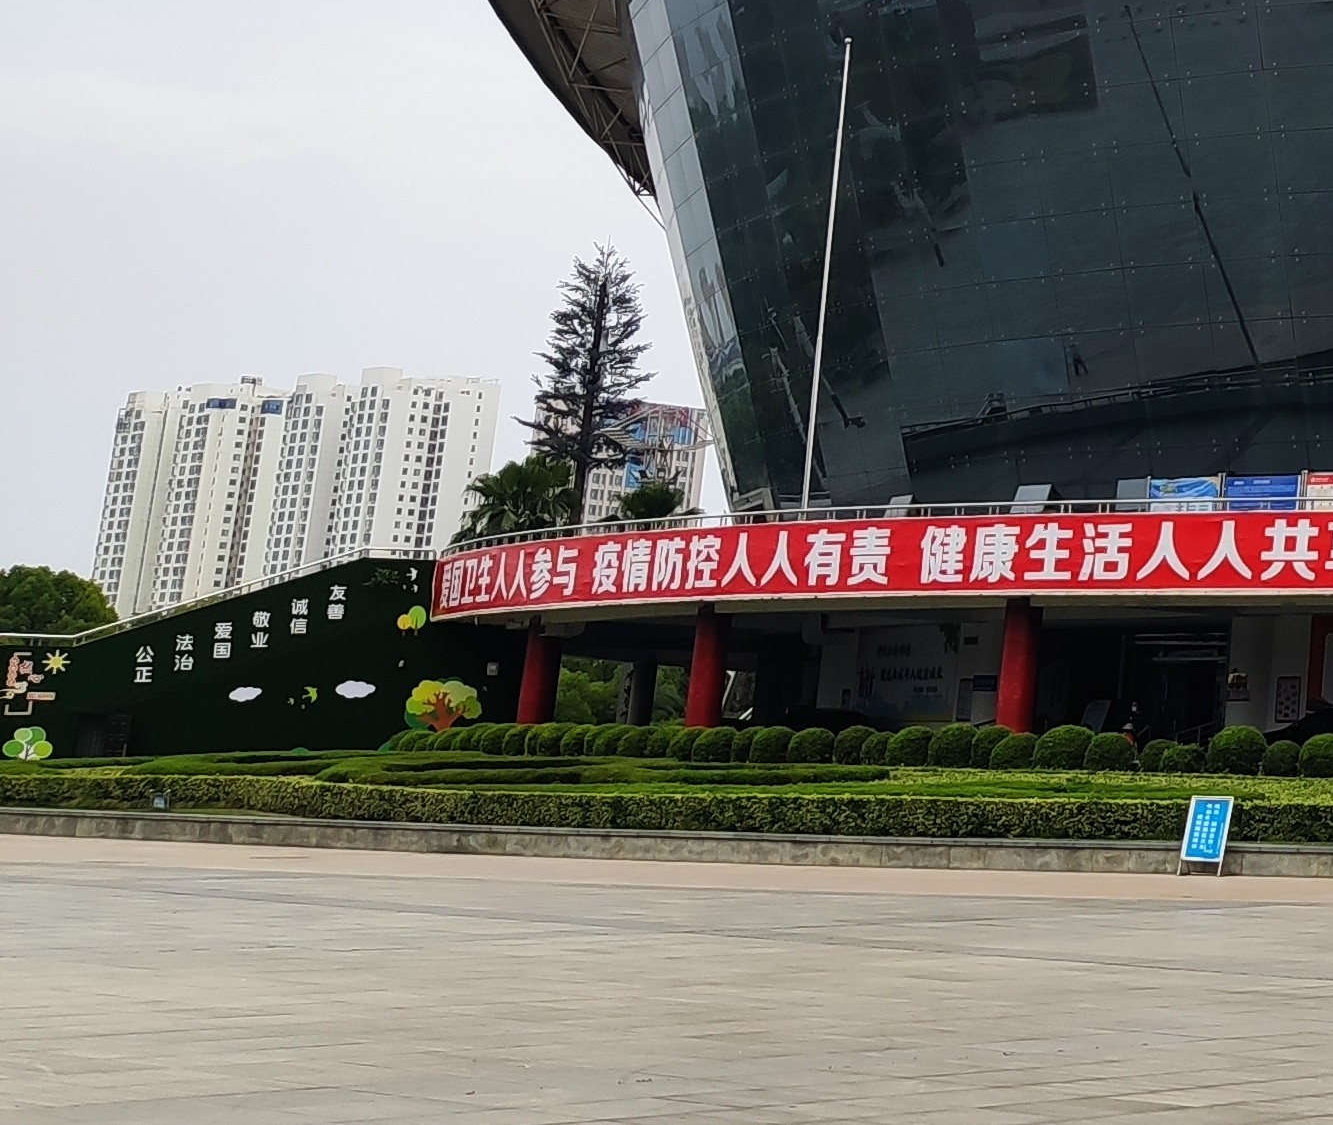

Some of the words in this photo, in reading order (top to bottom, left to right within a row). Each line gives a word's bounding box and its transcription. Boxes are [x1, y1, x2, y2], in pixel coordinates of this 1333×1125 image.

[439, 545, 579, 610] 爱国卫生人人参与
[590, 526, 892, 594] 疫情防控人人有责
[289, 598, 309, 635] 诚信
[326, 584, 348, 620] 友善
[212, 622, 233, 659] 爱国
[250, 610, 271, 648] 敬业
[133, 645, 154, 683] 公正
[173, 633, 194, 671] 法治
